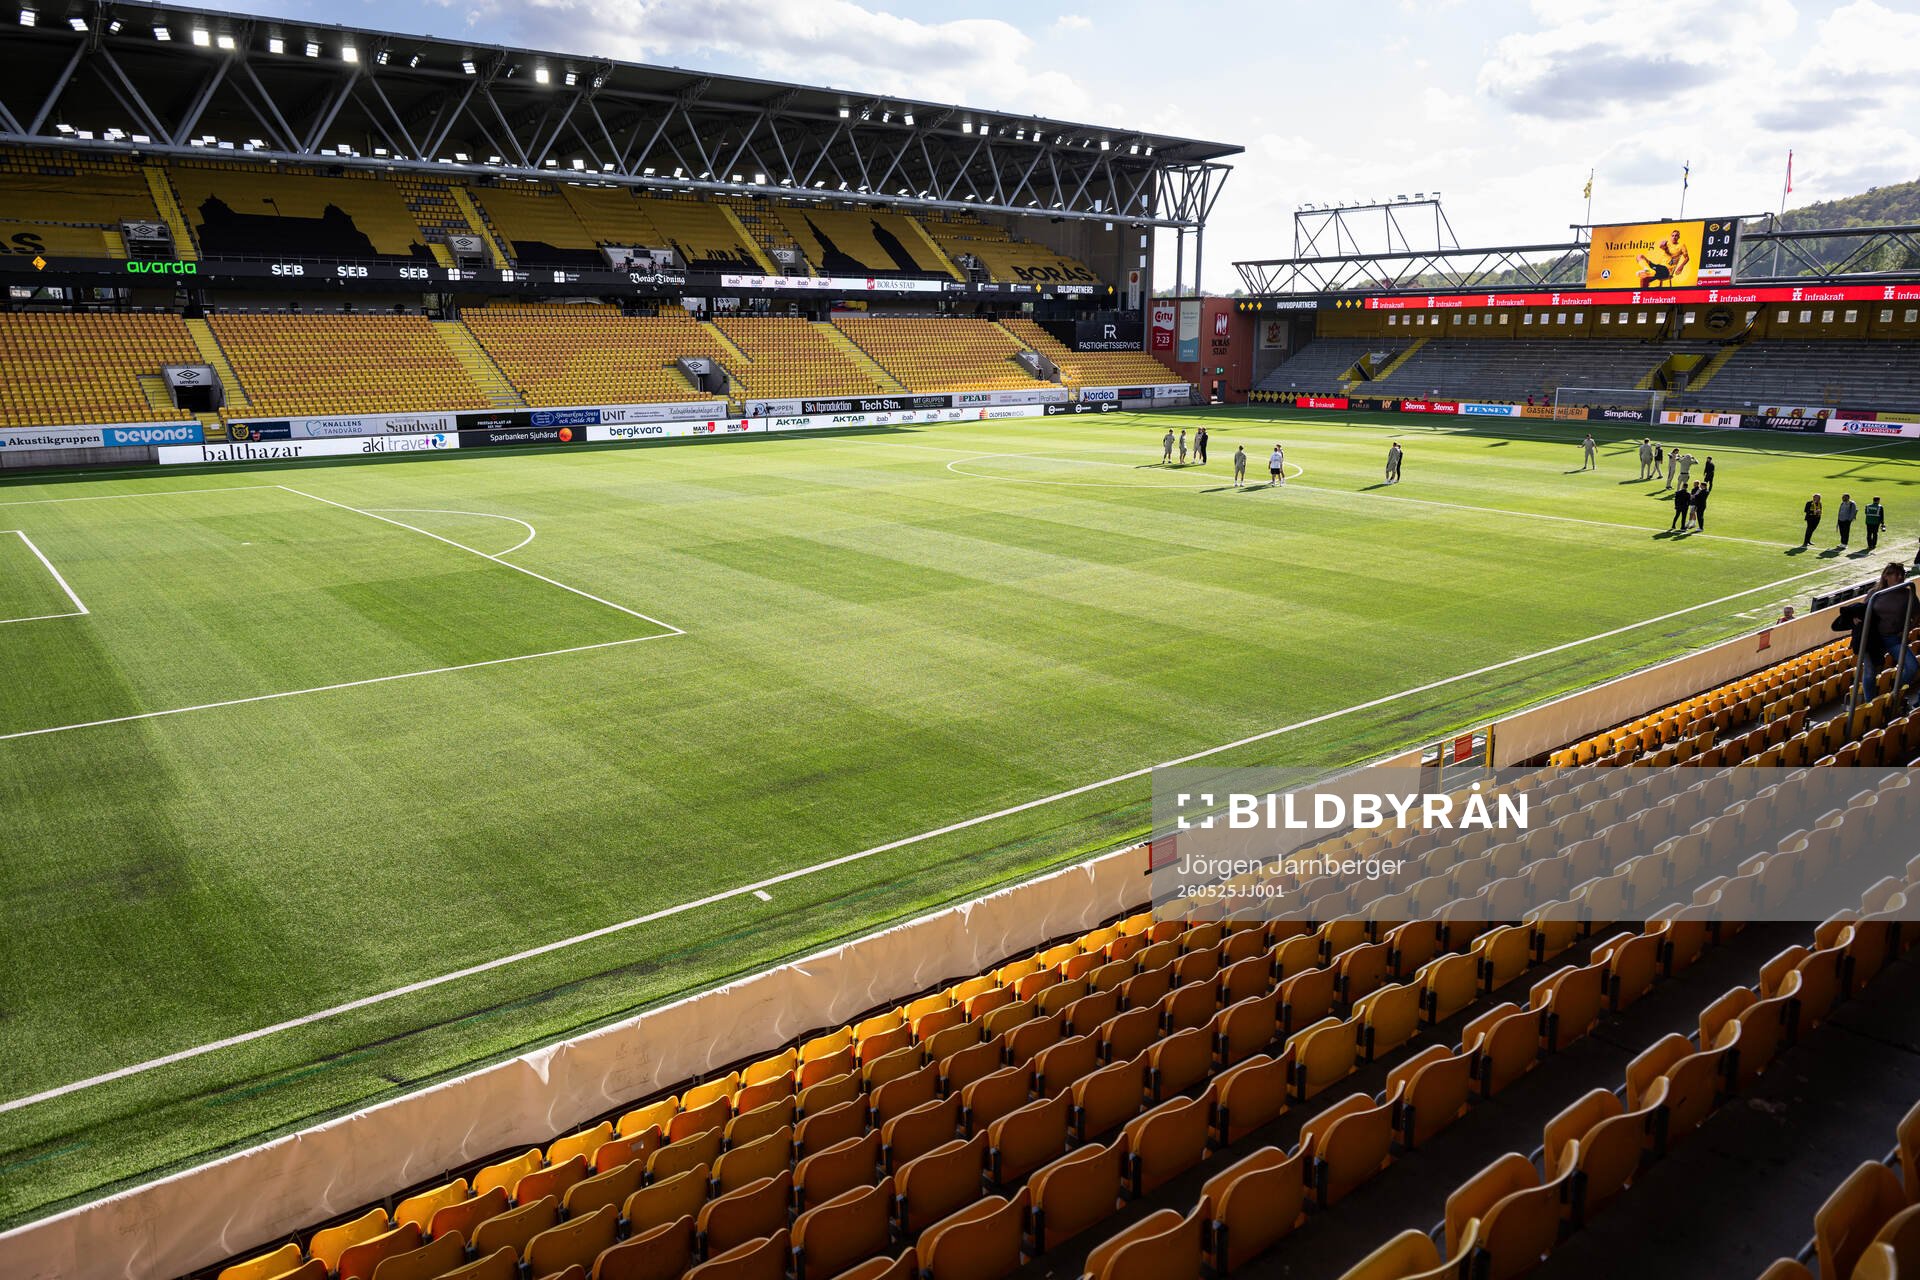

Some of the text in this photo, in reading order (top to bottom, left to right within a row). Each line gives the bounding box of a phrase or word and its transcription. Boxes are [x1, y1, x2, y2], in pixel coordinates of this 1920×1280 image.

[1605, 239, 1655, 251] Matchdag
[1708, 236, 1714, 245] 0
[1724, 235, 1730, 245] 0
[1707, 249, 1728, 257] 17:42
[127, 261, 197, 274] avarda
[271, 263, 304, 276] SEB
[337, 265, 368, 278] SEB
[400, 266, 429, 280] SEB
[1011, 262, 1094, 281] BORÅS
[629, 273, 685, 285] Borås Tidning
[877, 279, 898, 289] BORÅS
[1057, 285, 1093, 294] GULDPARTNERS
[1496, 298, 1525, 306] Infrakraft
[1561, 297, 1592, 305] Infrakraft
[1642, 295, 1676, 304] Infrakraft
[1720, 294, 1757, 303] Infrakraft
[1804, 292, 1845, 302] Infrakraft
[1155, 311, 1173, 322] City
[1104, 324, 1117, 339] FR
[1084, 390, 1114, 401] Nordea
[860, 401, 881, 410] Tech
[1466, 405, 1511, 414] JENSEN
[602, 410, 626, 421] UNIT
[1604, 410, 1643, 419] Simplicity.
[1683, 415, 1696, 424] put
[386, 419, 448, 432] Sandwall
[1718, 416, 1731, 425] put
[324, 427, 363, 435] TANDVÅRD
[490, 431, 558, 442] Sparbanken Sjuhärad
[609, 425, 663, 437] bergkvara
[8, 434, 101, 446] Akustikgruppen
[362, 435, 431, 453] aki travel
[202, 443, 303, 462] balthazar
